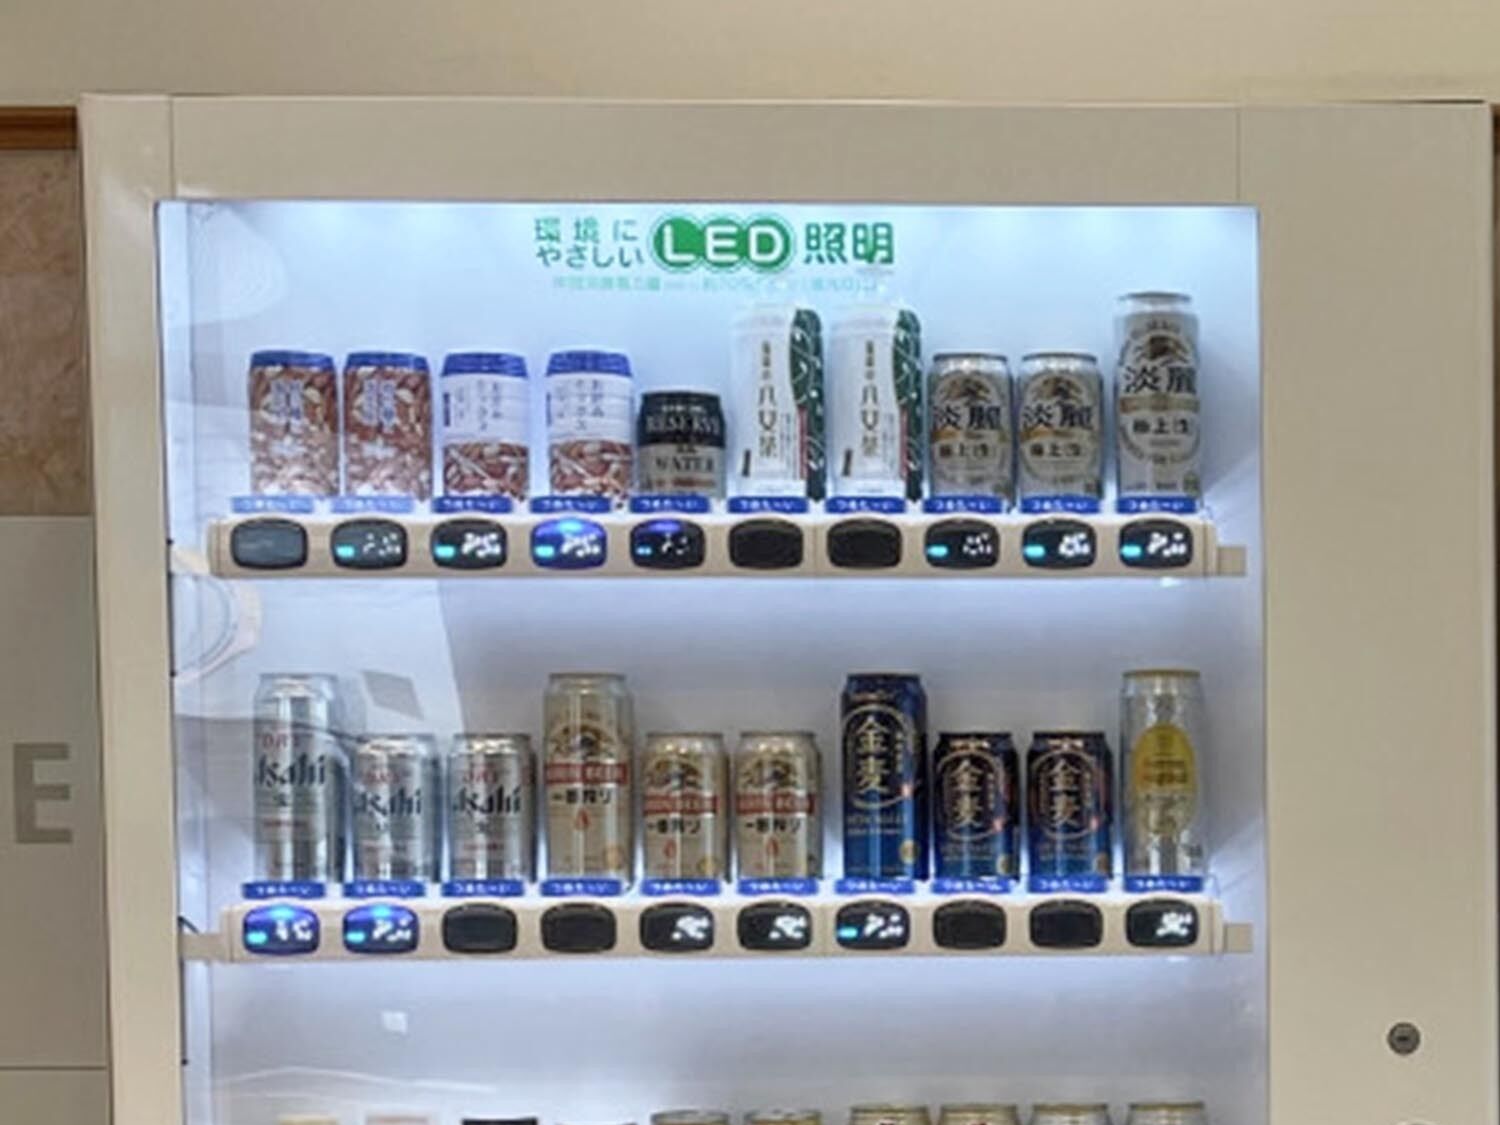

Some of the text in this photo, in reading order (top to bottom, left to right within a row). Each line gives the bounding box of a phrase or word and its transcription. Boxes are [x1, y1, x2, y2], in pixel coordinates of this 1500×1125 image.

[534, 217, 639, 244] 環境に
[536, 245, 643, 269] やさしい
[804, 222, 894, 264] 照明
[856, 714, 890, 794] 金麦
[14, 743, 72, 844] E
[949, 758, 984, 828] 金麦
[1045, 758, 1080, 828] 金麦
